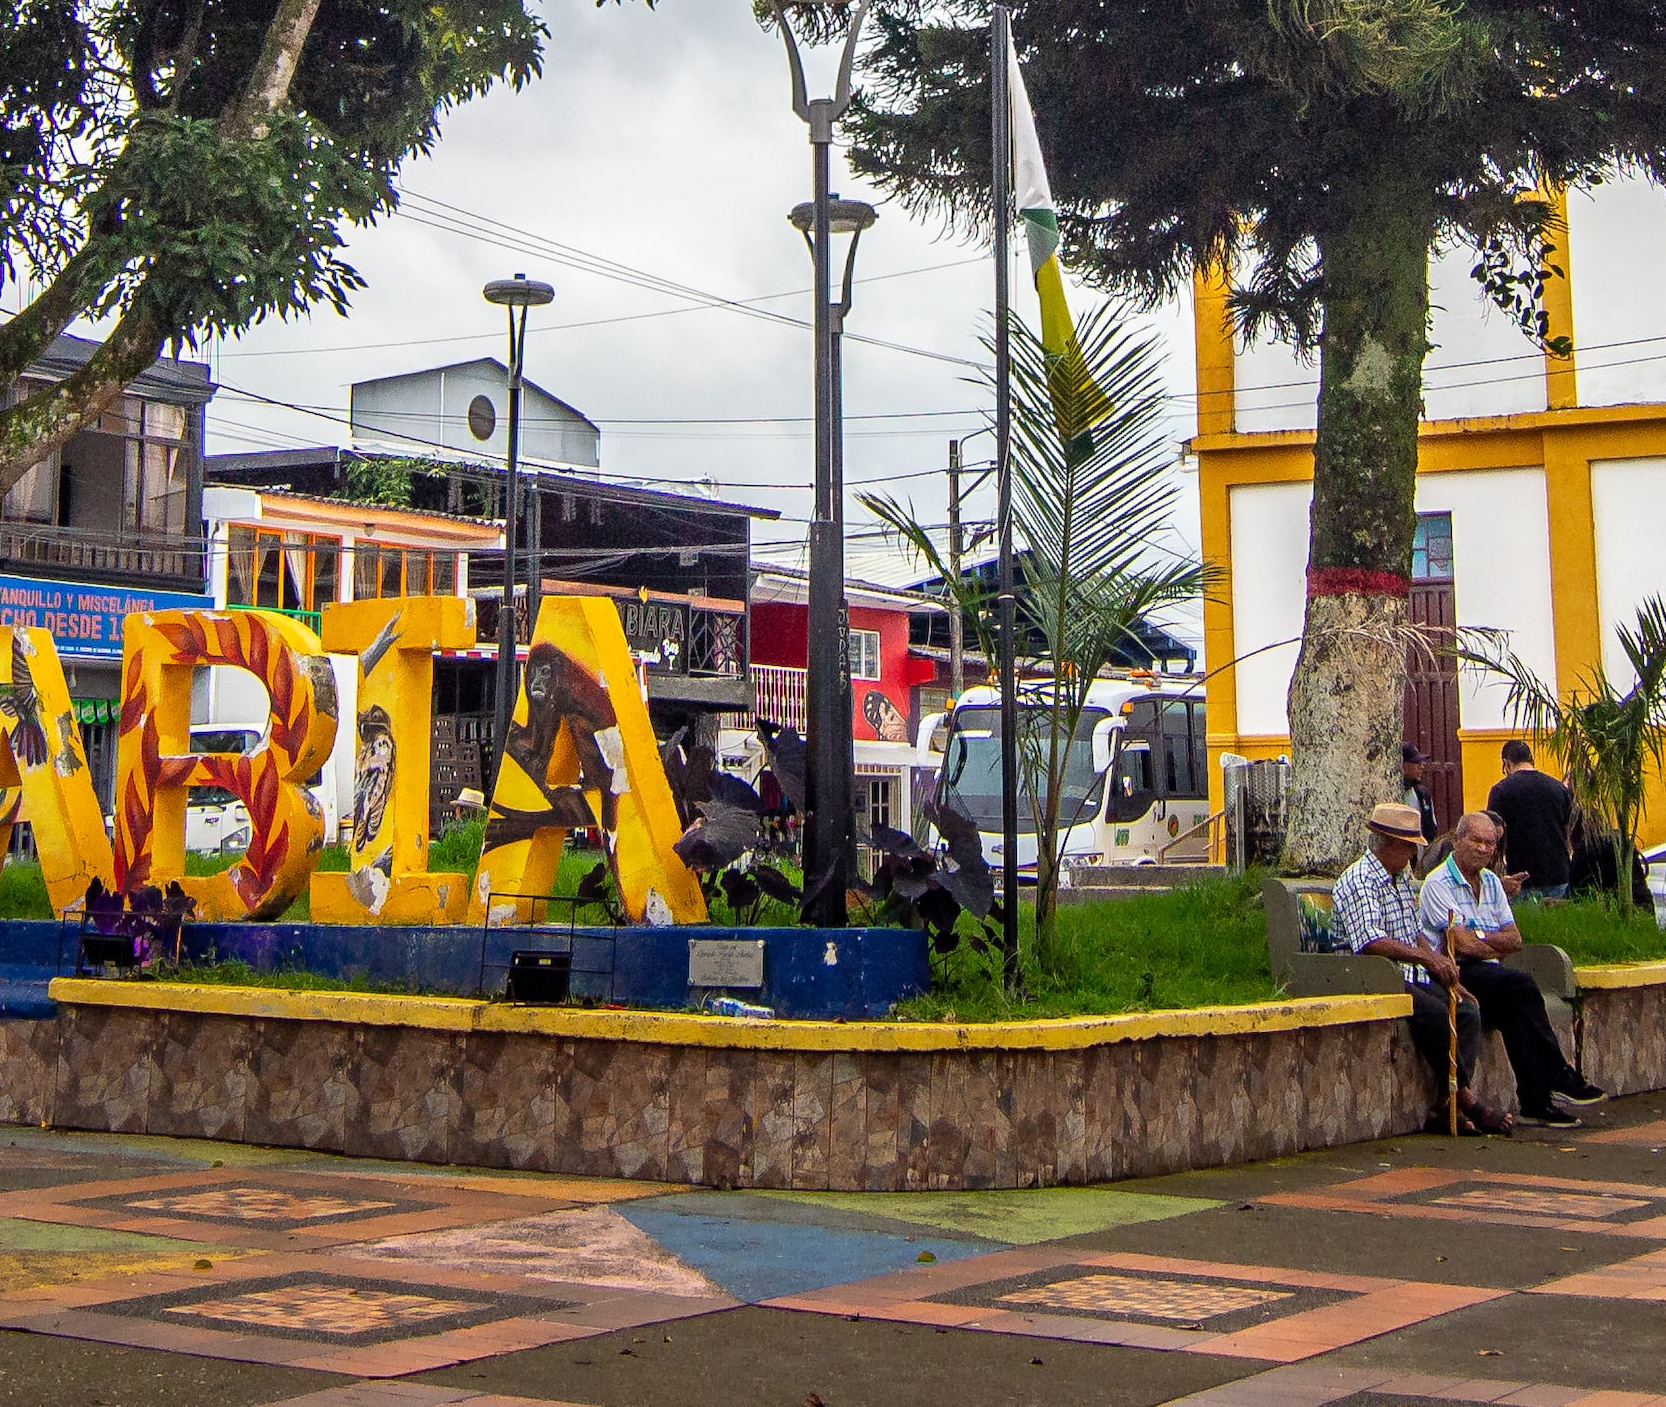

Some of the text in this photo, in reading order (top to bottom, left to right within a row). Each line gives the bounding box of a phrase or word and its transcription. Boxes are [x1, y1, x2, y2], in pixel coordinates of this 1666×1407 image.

[67, 593, 74, 610] Y
[78, 594, 155, 614] MISCELÁNEA
[44, 611, 102, 640] DESDE
